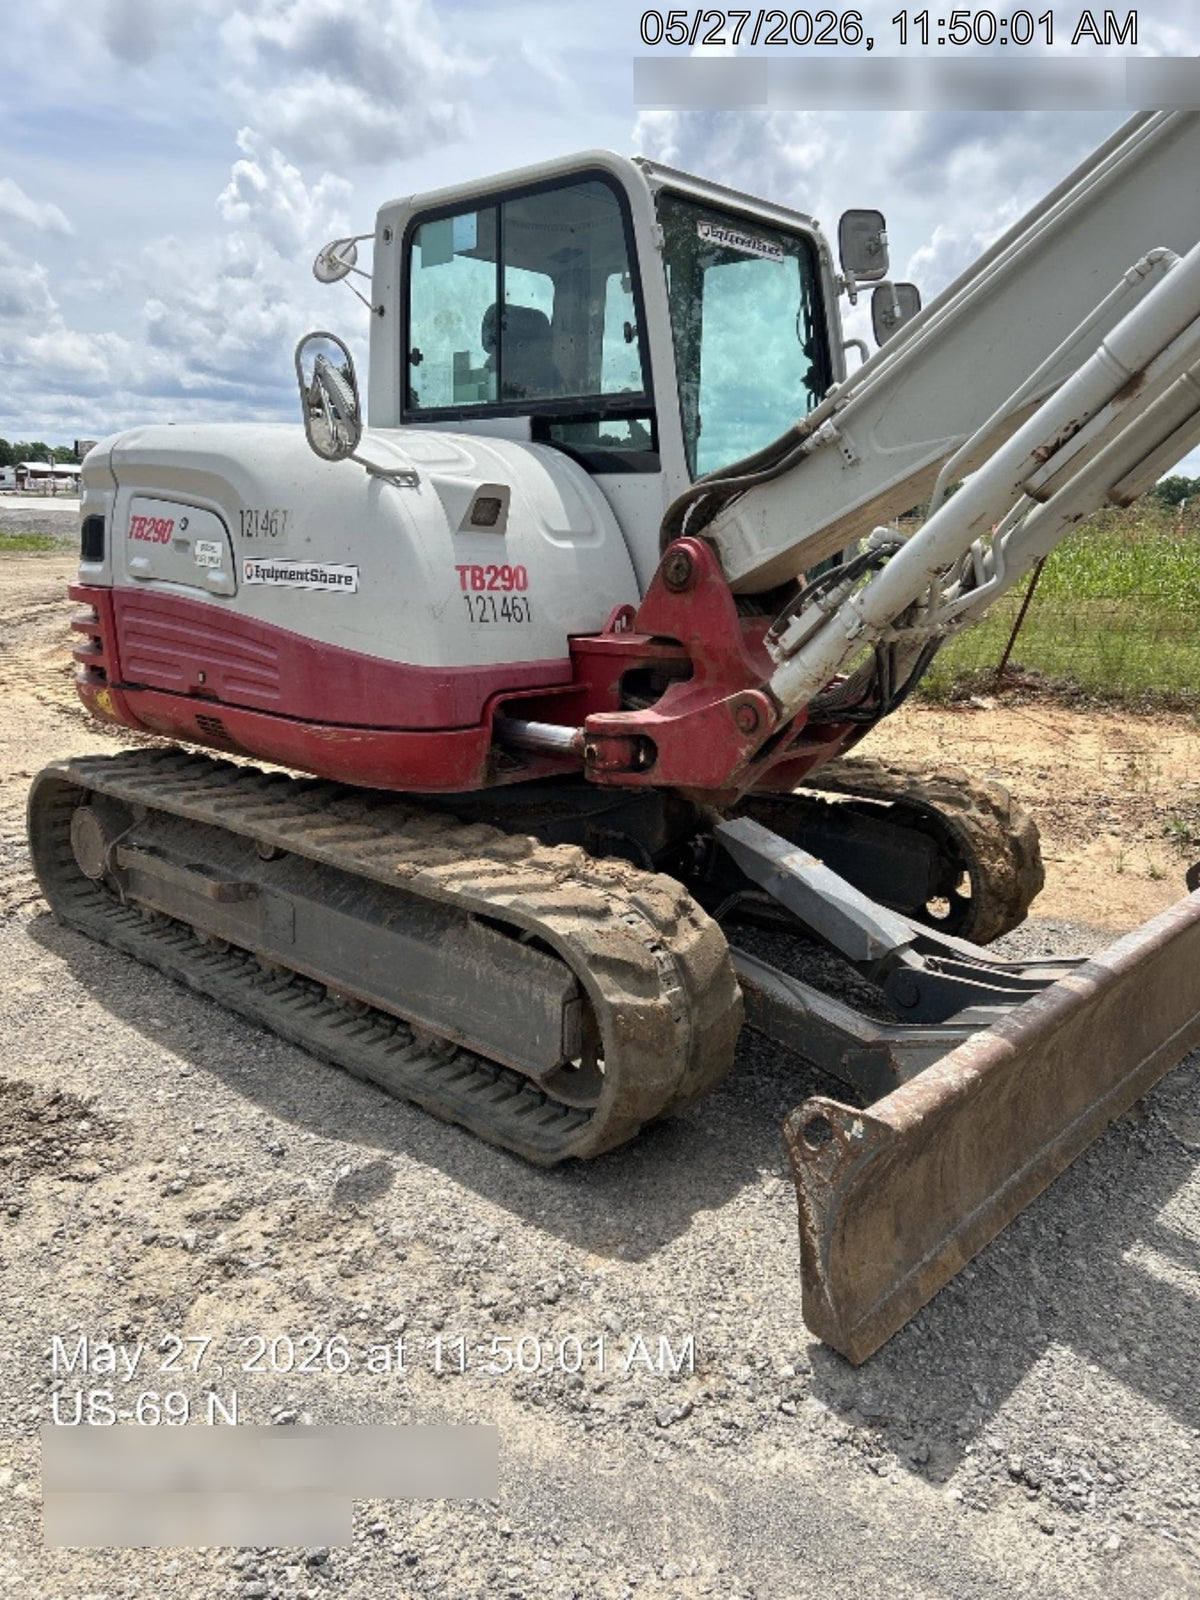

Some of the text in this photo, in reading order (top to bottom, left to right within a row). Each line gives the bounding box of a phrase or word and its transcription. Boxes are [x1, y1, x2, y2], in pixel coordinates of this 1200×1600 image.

[128, 515, 174, 544] TB290
[254, 565, 353, 586] EquipmentShare
[455, 564, 528, 591] TB290
[464, 595, 532, 623] 121461
